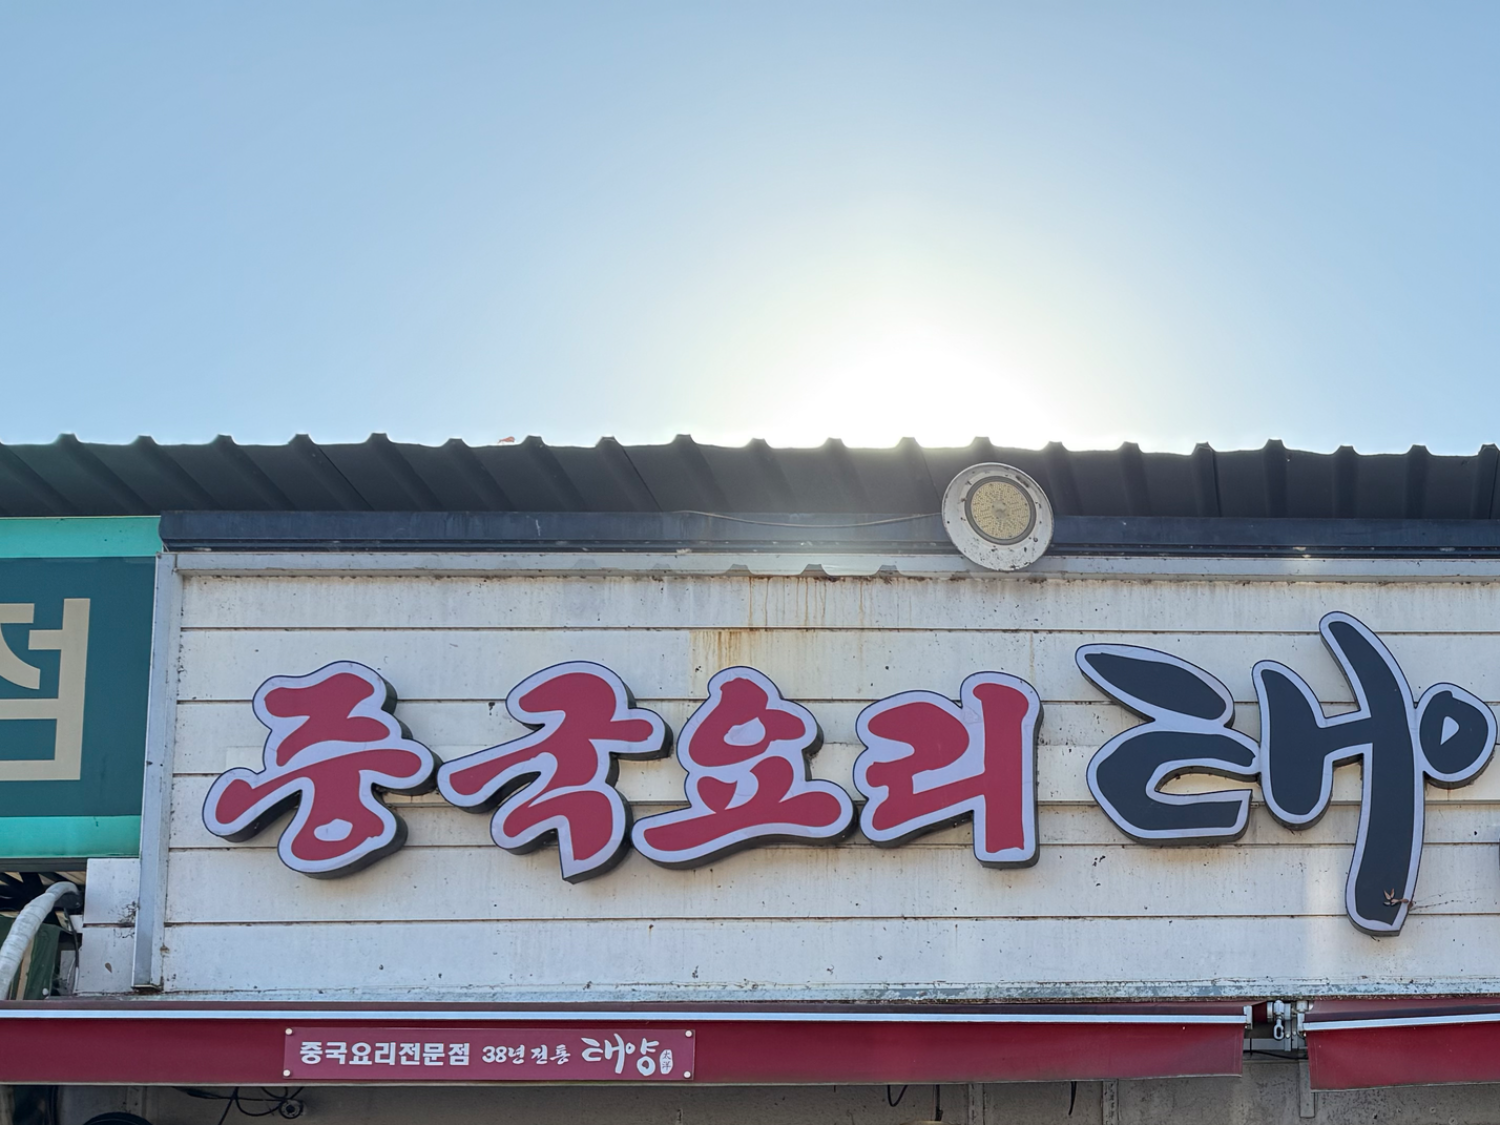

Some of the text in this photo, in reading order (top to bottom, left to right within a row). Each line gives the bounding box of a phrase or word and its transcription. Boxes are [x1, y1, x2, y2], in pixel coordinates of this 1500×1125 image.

[203, 661, 1043, 883] 중국요리
[300, 1033, 659, 1076] 중국요리전문점 38년 전통 태양
